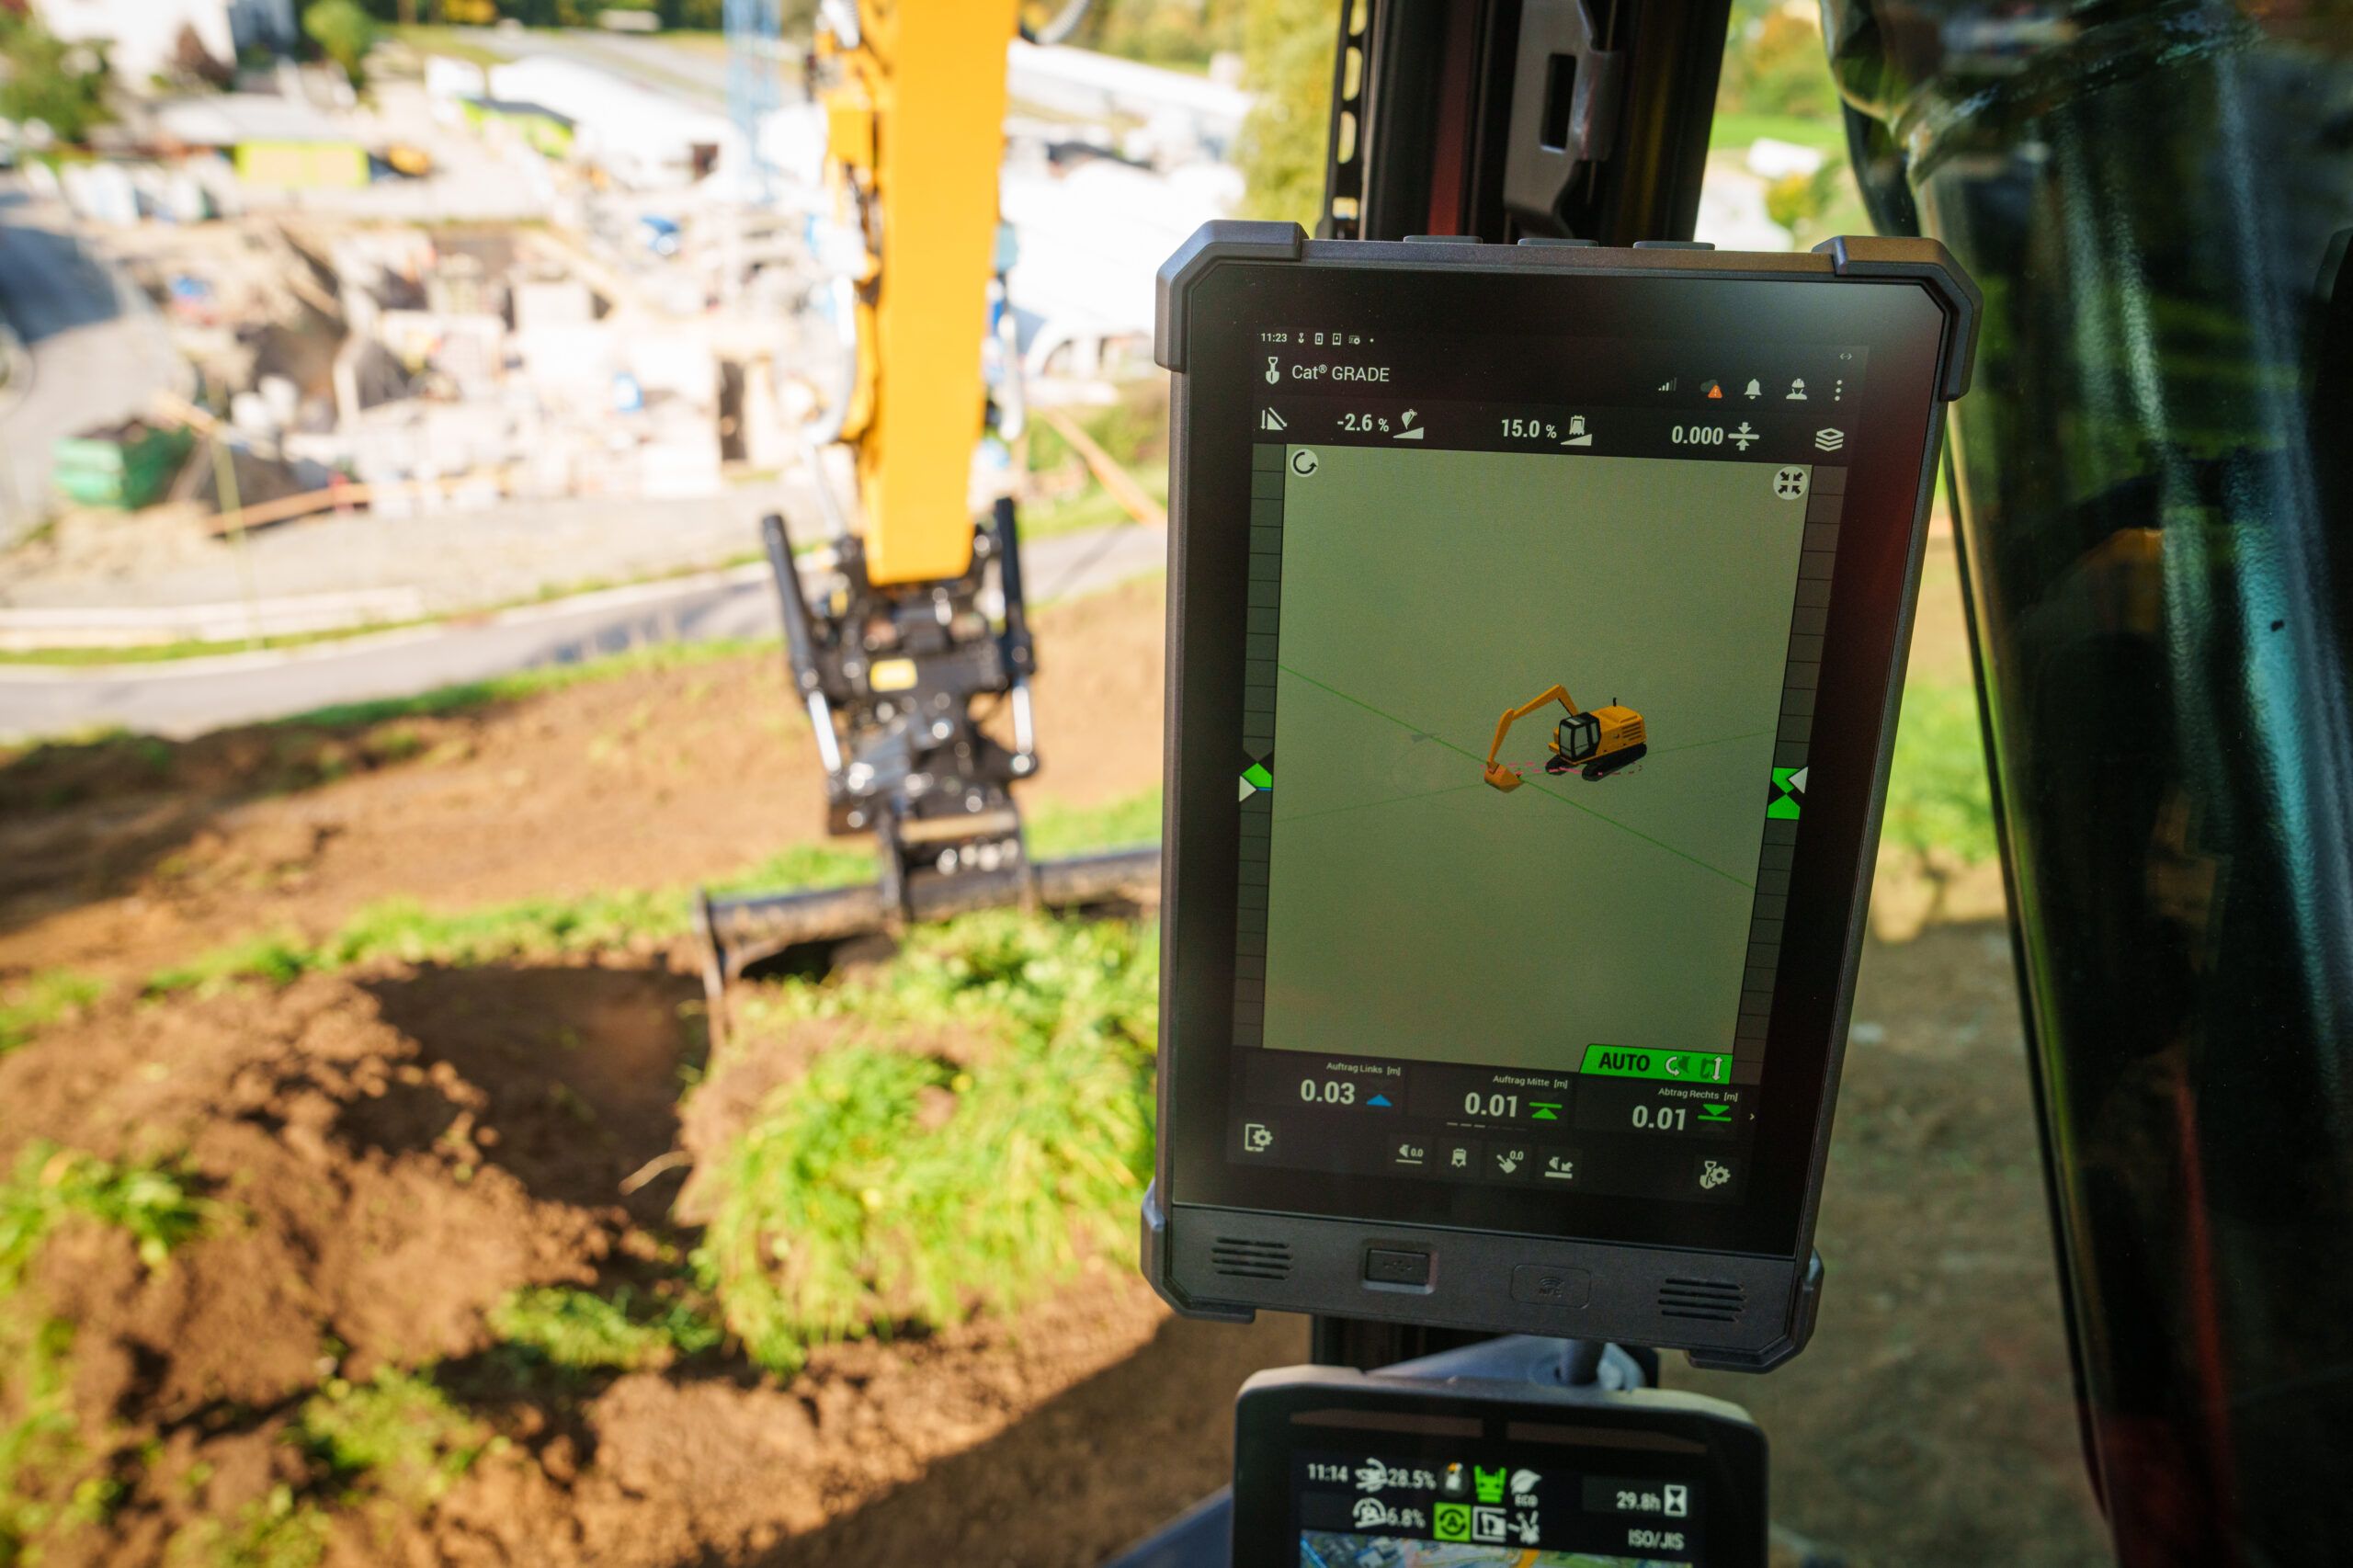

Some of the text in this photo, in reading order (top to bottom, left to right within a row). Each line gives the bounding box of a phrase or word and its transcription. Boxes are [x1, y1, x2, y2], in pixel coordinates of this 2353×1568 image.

[1260, 332, 1288, 344] 11:23
[1332, 367, 1390, 382] GRADE
[1336, 414, 1390, 433] -2.6 %
[1501, 419, 1557, 439] 15.0 %
[1671, 426, 1724, 446] 0.000
[1326, 1062, 1358, 1074] Auftrag
[1359, 1063, 1382, 1074] Links
[1598, 1051, 1650, 1072] AUTO
[1493, 1074, 1526, 1086] Auftrag
[1527, 1077, 1550, 1087] Mitte
[1300, 1079, 1356, 1105] 0.03
[1658, 1087, 1688, 1100] Abtrag
[1689, 1089, 1720, 1100] Rechts
[1464, 1092, 1518, 1118] 0.01
[1631, 1105, 1687, 1131] 0.01
[1307, 1463, 1348, 1483] 11:14
[1387, 1468, 1437, 1490] 28.5%
[1386, 1506, 1426, 1528] 6.8%
[1628, 1528, 1685, 1551] ISO/JIS
